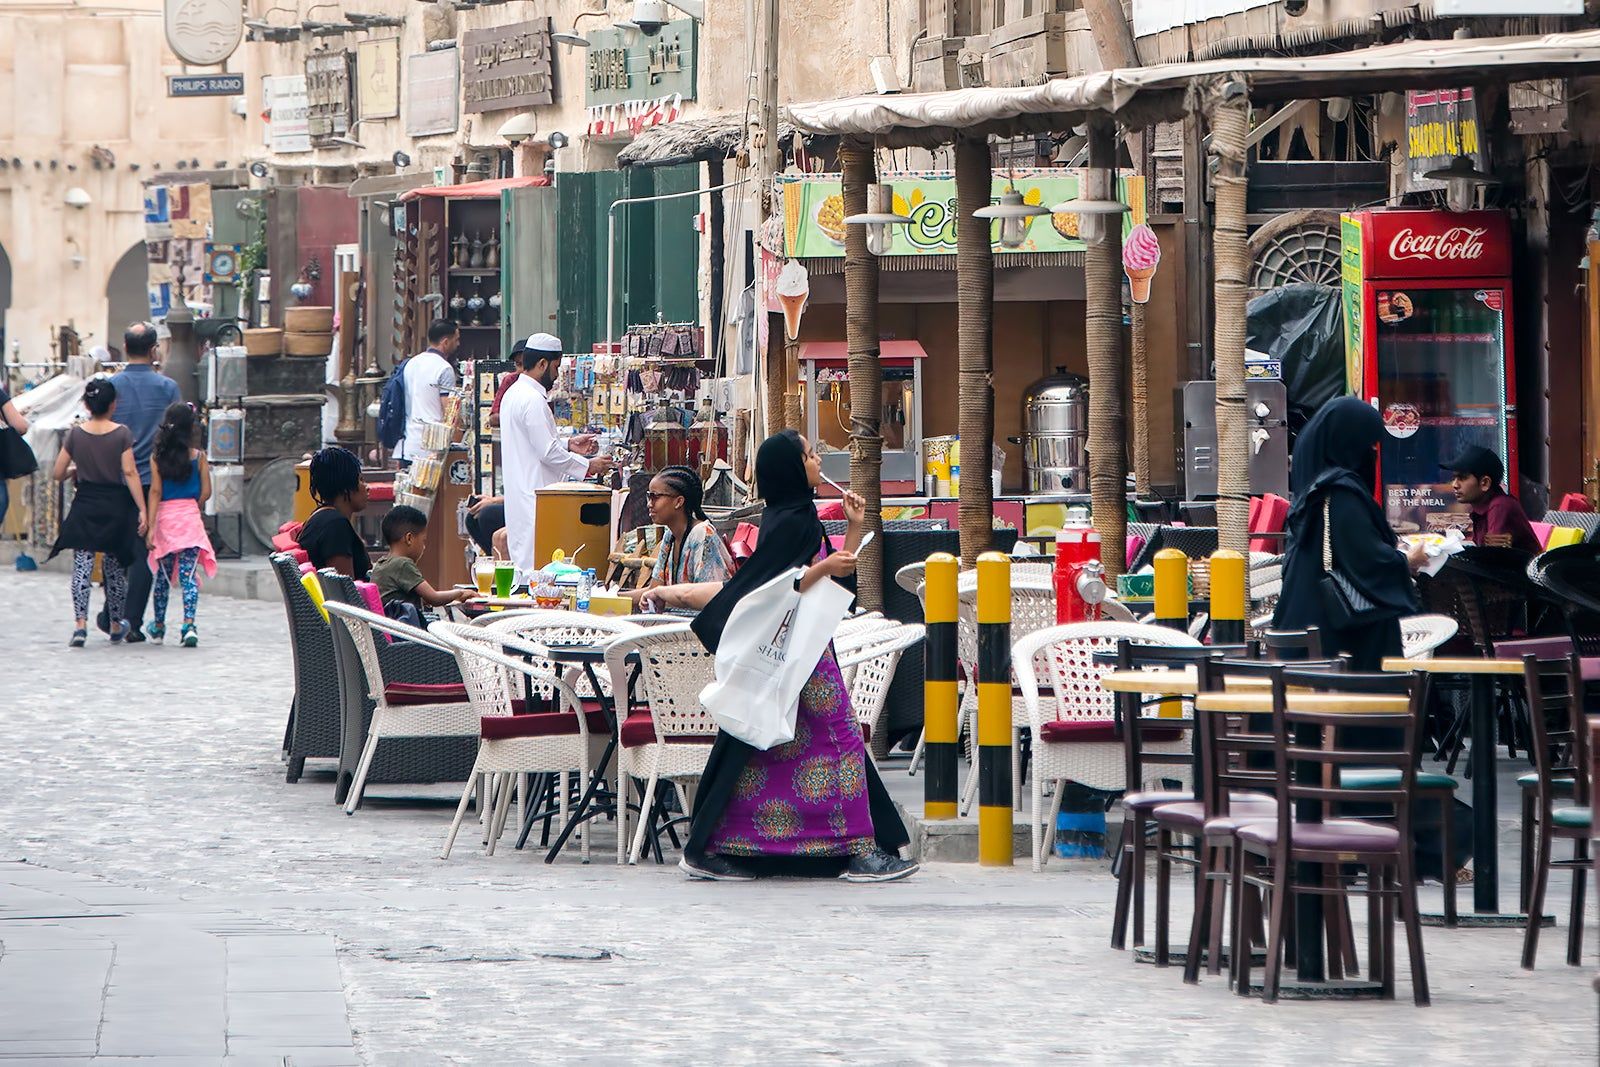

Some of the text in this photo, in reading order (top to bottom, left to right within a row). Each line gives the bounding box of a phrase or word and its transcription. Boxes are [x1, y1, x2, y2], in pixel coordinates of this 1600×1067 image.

[173, 79, 241, 91] PHILIPS RADIO
[1389, 227, 1488, 261] Coca-Cola
[1388, 488, 1432, 497] BEST PART
[1388, 498, 1445, 506] OF THE MEAL
